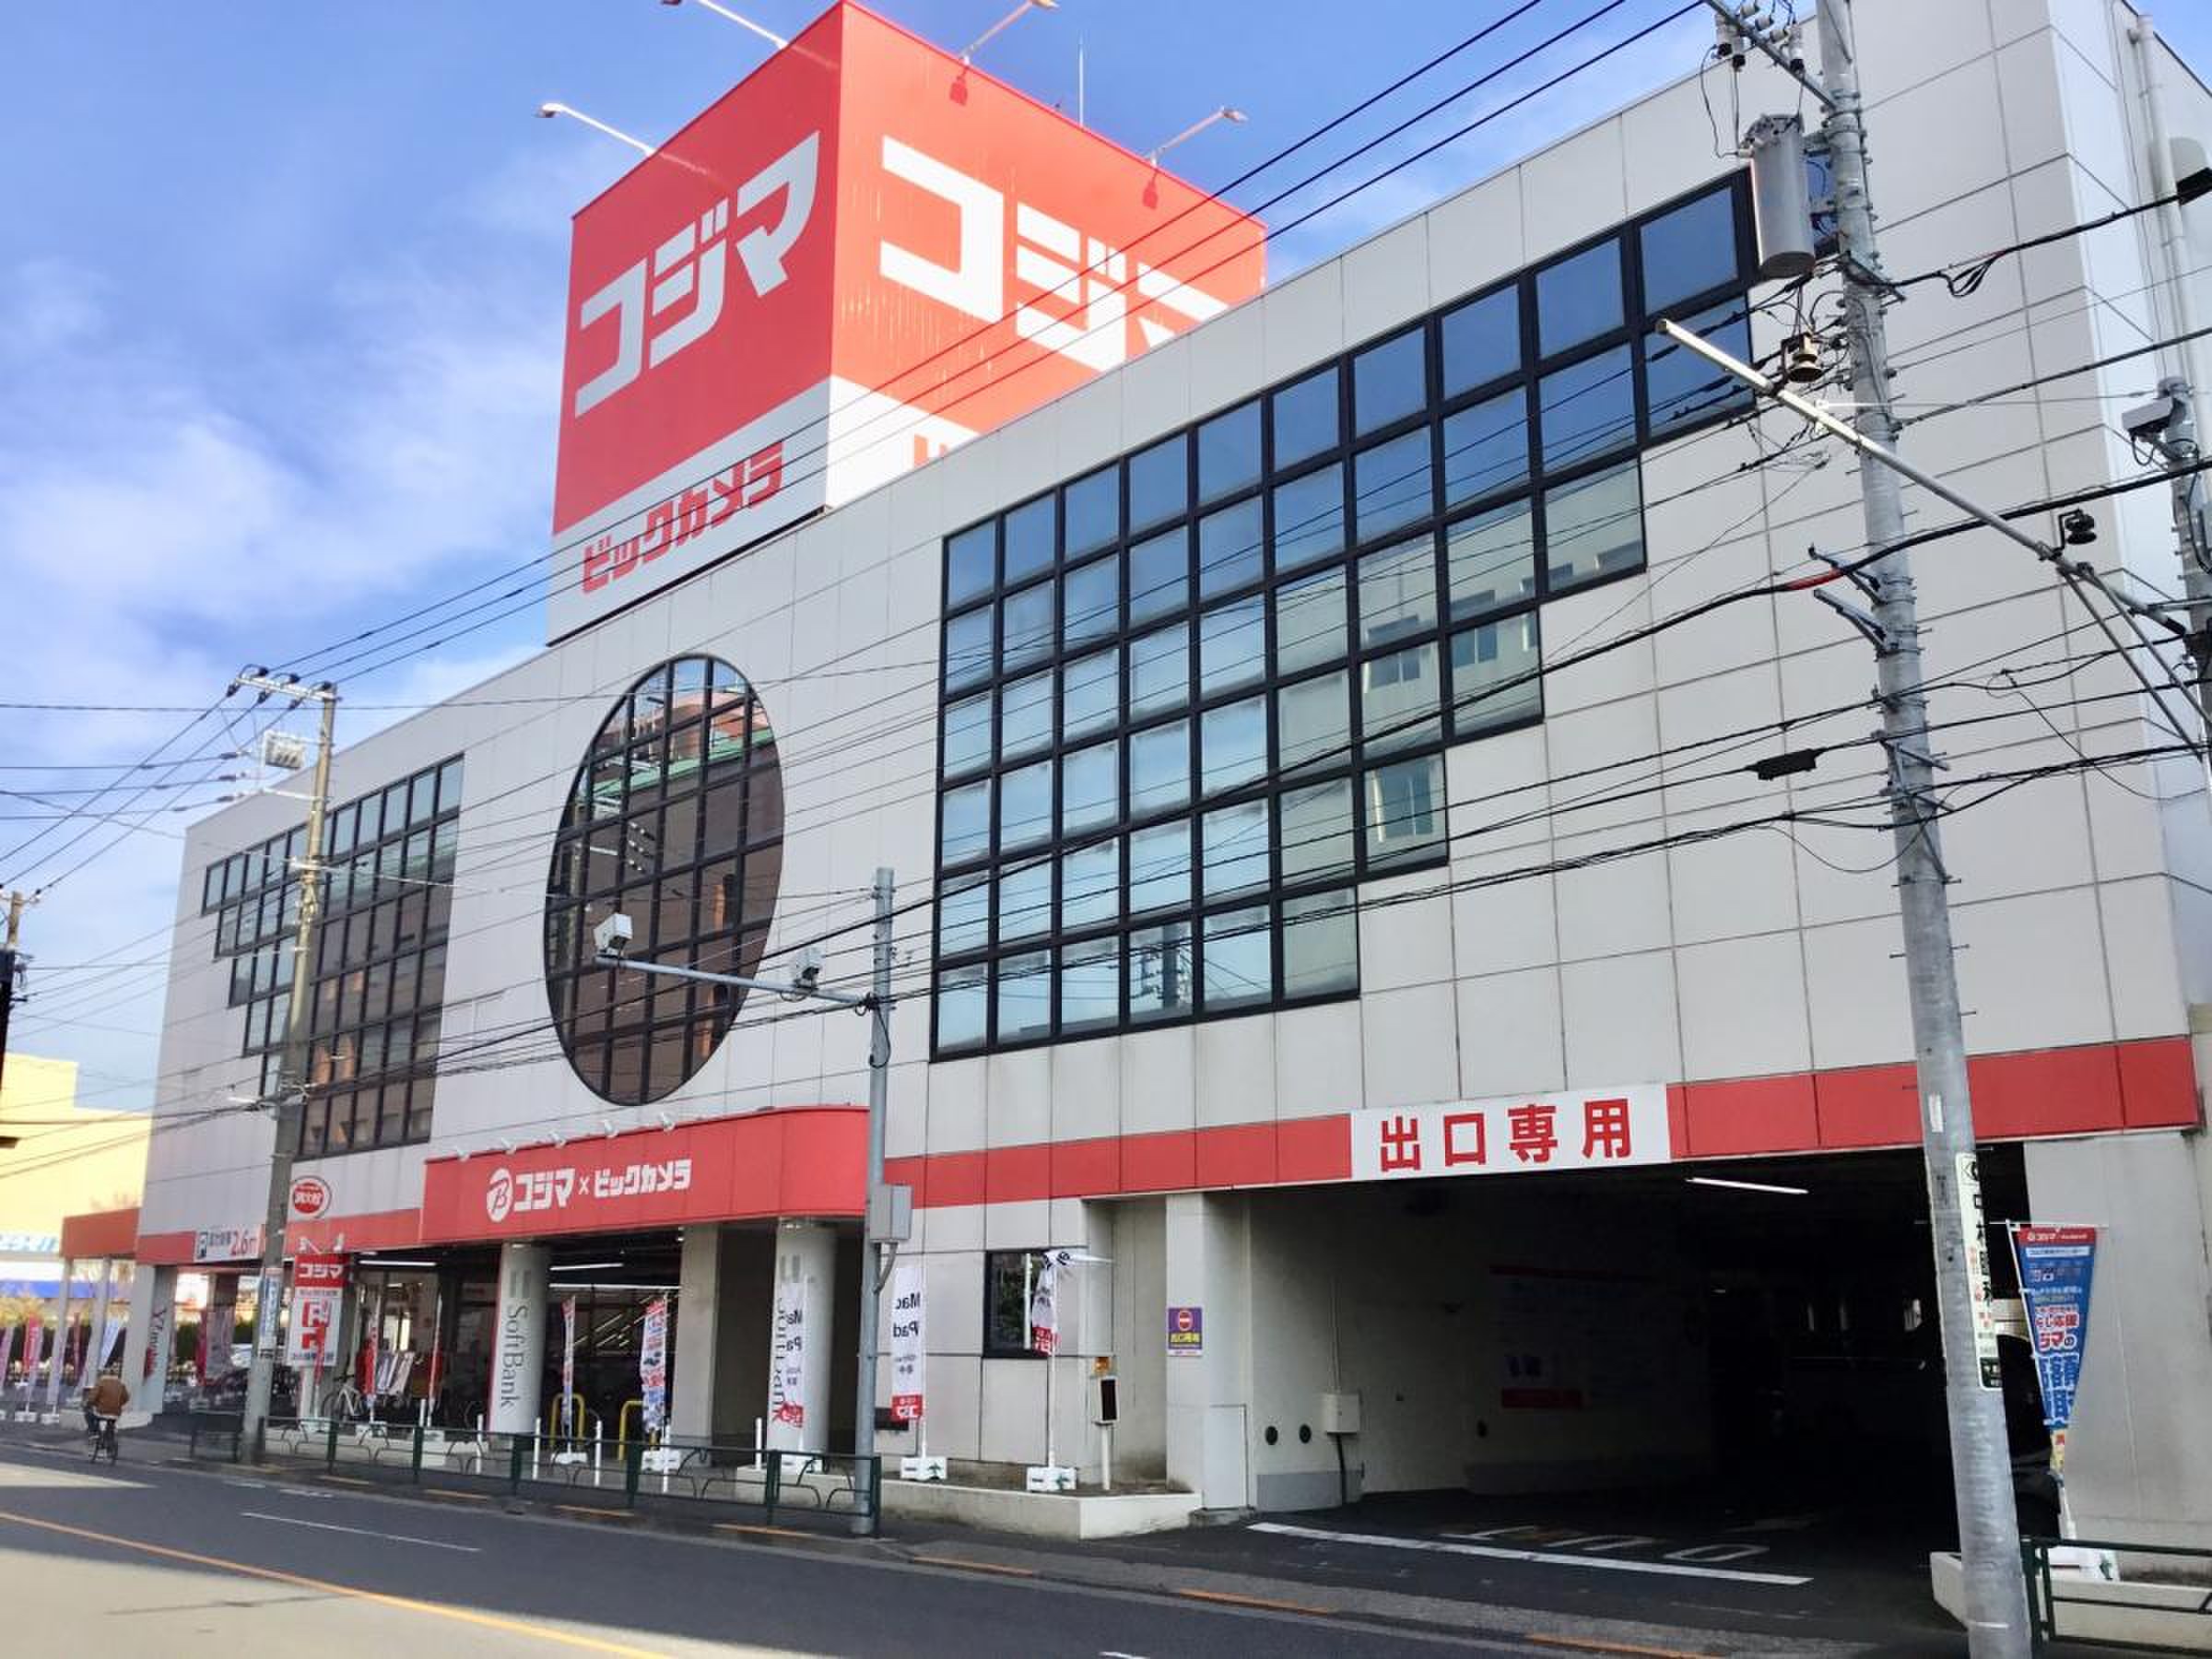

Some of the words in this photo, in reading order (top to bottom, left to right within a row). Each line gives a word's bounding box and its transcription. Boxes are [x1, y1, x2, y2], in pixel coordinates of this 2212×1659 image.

[575, 131, 819, 418] コジマ
[582, 441, 782, 594] ビックカメラ
[1380, 1098, 1631, 1172] 出口専用
[298, 1264, 344, 1279] コジマ
[500, 1305, 530, 1408] SoftBank
